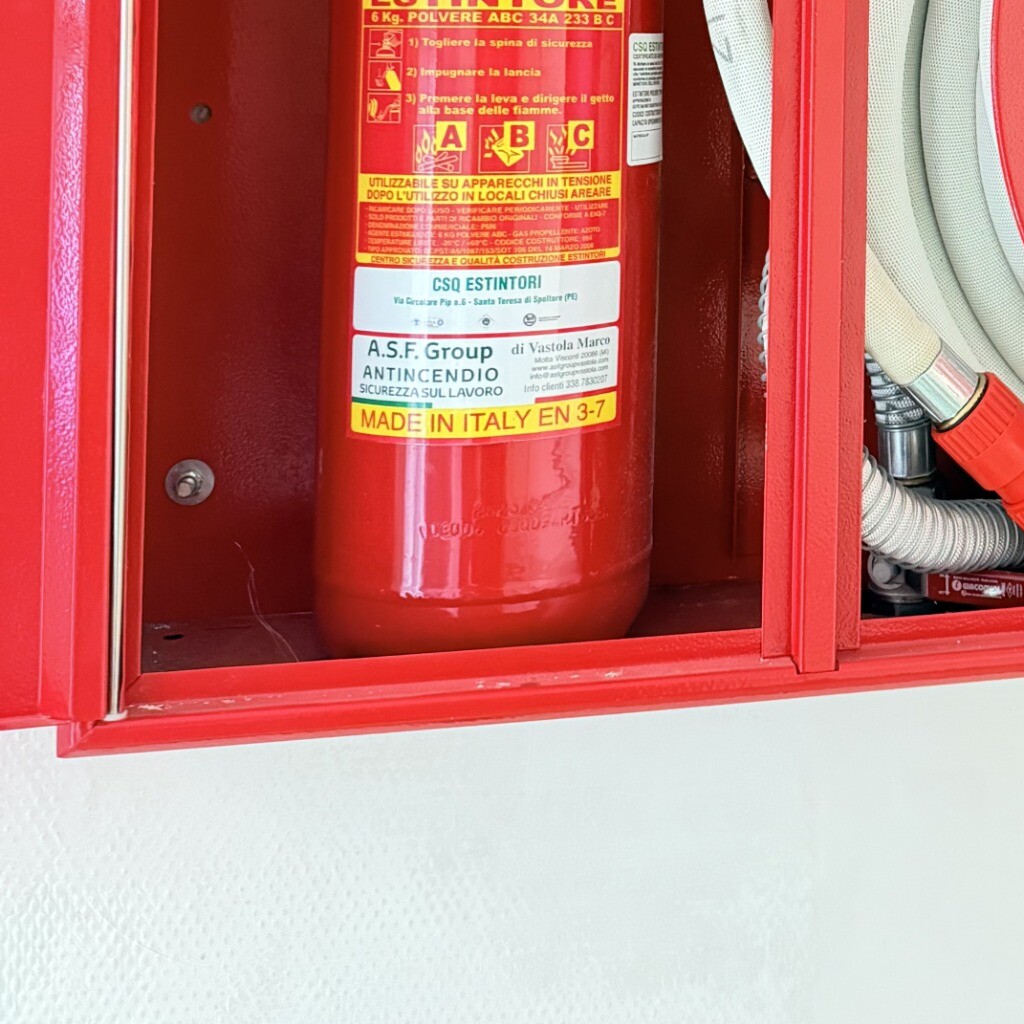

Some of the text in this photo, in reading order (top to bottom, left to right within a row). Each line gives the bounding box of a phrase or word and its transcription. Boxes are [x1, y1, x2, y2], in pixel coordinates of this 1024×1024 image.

[371, 11, 615, 26] 6 Kg. POLVERE ABC 34A 233 B C
[408, 37, 593, 49] 1) Togliere la spina di sicurezza
[406, 67, 542, 78] 2) Impugnare la lancia
[405, 93, 615, 106] 3) Premere la leva e dirigere il getto
[418, 105, 562, 115] alla base delle fiamme.
[440, 124, 463, 148] A
[510, 124, 530, 148] B
[573, 123, 591, 147] C
[368, 174, 613, 189] UTILIZZABILE SU APPARECCHI IN TENSIONE
[367, 189, 394, 200] DOPO
[462, 191, 475, 202] IN
[478, 190, 525, 202] LOCALI
[528, 188, 569, 200] CHIUSI
[570, 186, 612, 198] AREARE
[370, 250, 606, 266] CENTRO SICUREZZA E QUALITÀ COSTRUZIONE ESTINTORI
[432, 274, 542, 293] CSQ ESTINTORI
[393, 295, 404, 305] Via
[440, 297, 452, 308] Pip
[473, 297, 496, 306] Santa
[498, 296, 522, 306] Teresa
[524, 295, 532, 304] di
[564, 292, 578, 303] (PE)
[367, 338, 494, 364] A.S.F. Group
[511, 336, 611, 355] di Vastola Marco
[362, 364, 499, 384] ANTINCENDIO
[359, 383, 504, 398] SICUREZZA SUL LAVORO
[360, 398, 606, 433] MADE IN ITALY EN 3-7
